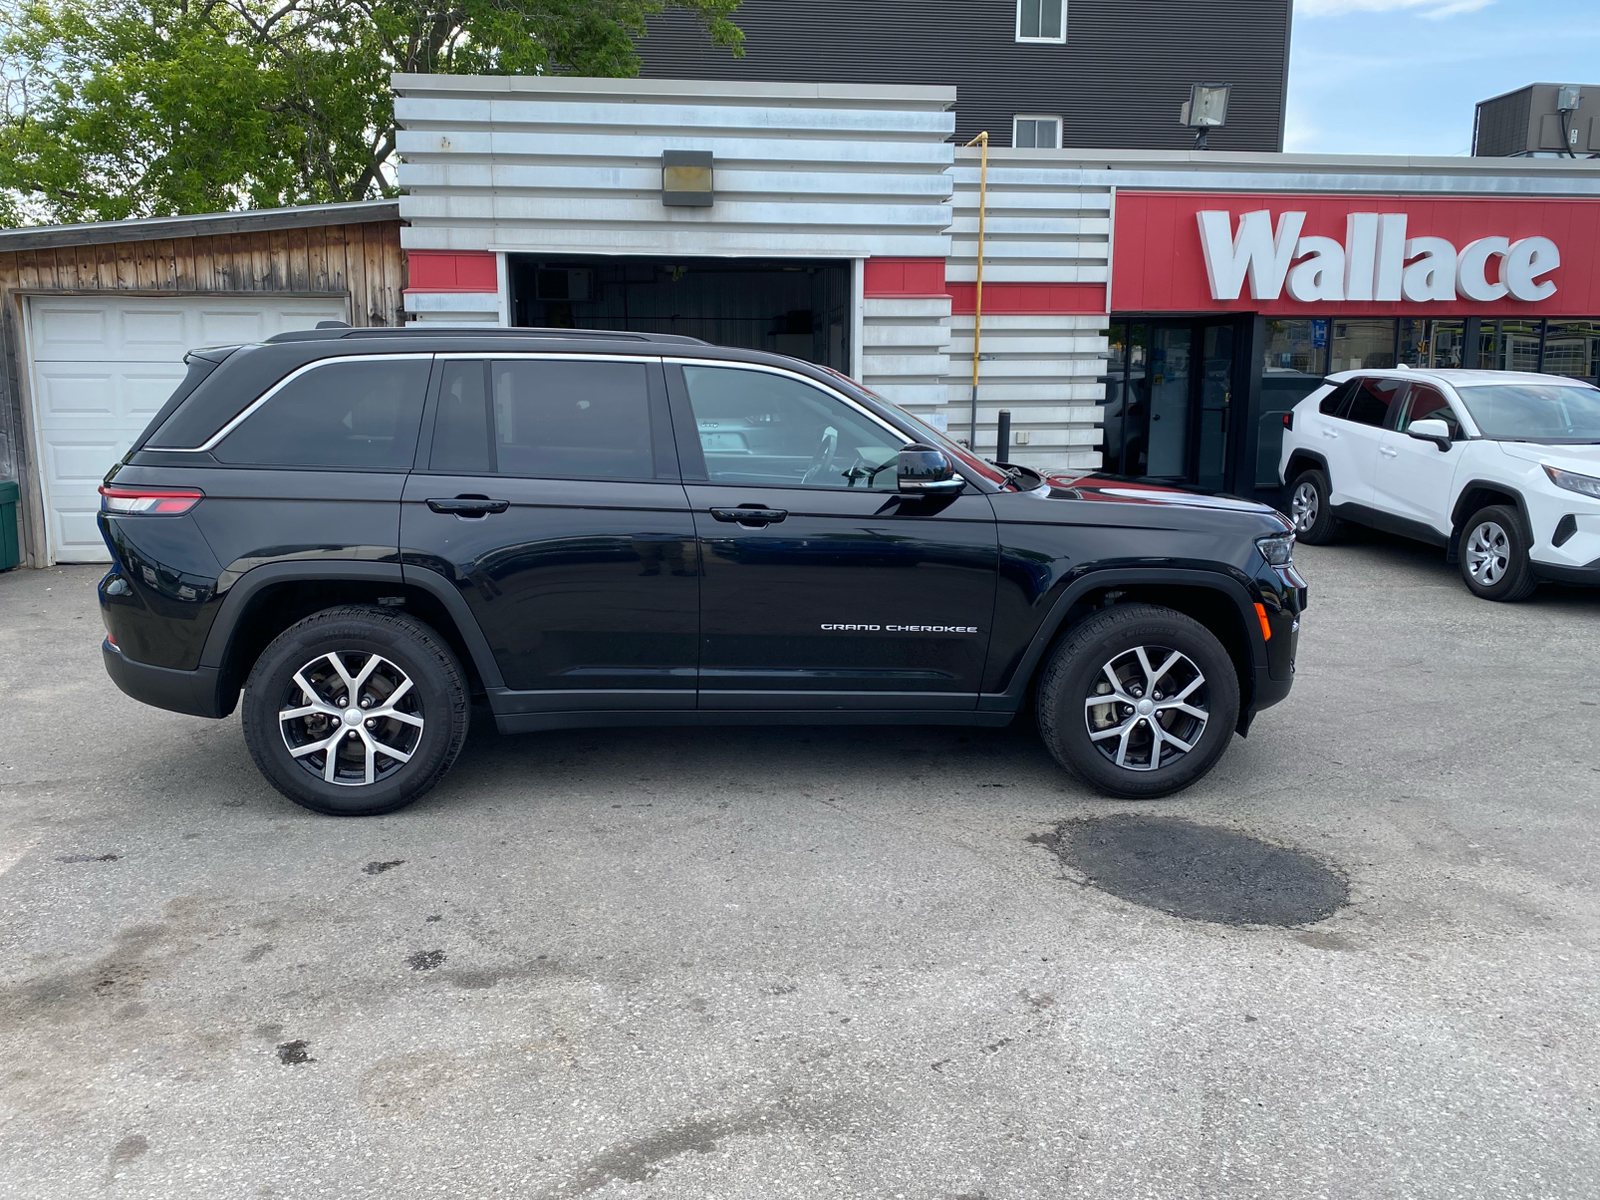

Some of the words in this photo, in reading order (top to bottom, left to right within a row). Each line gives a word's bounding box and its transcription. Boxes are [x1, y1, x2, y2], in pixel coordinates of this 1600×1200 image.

[1196, 209, 1561, 303] Wallace
[820, 623, 881, 631] GRAND
[885, 624, 978, 633] CHEROKEE
[1126, 626, 1176, 638] MICHELIN
